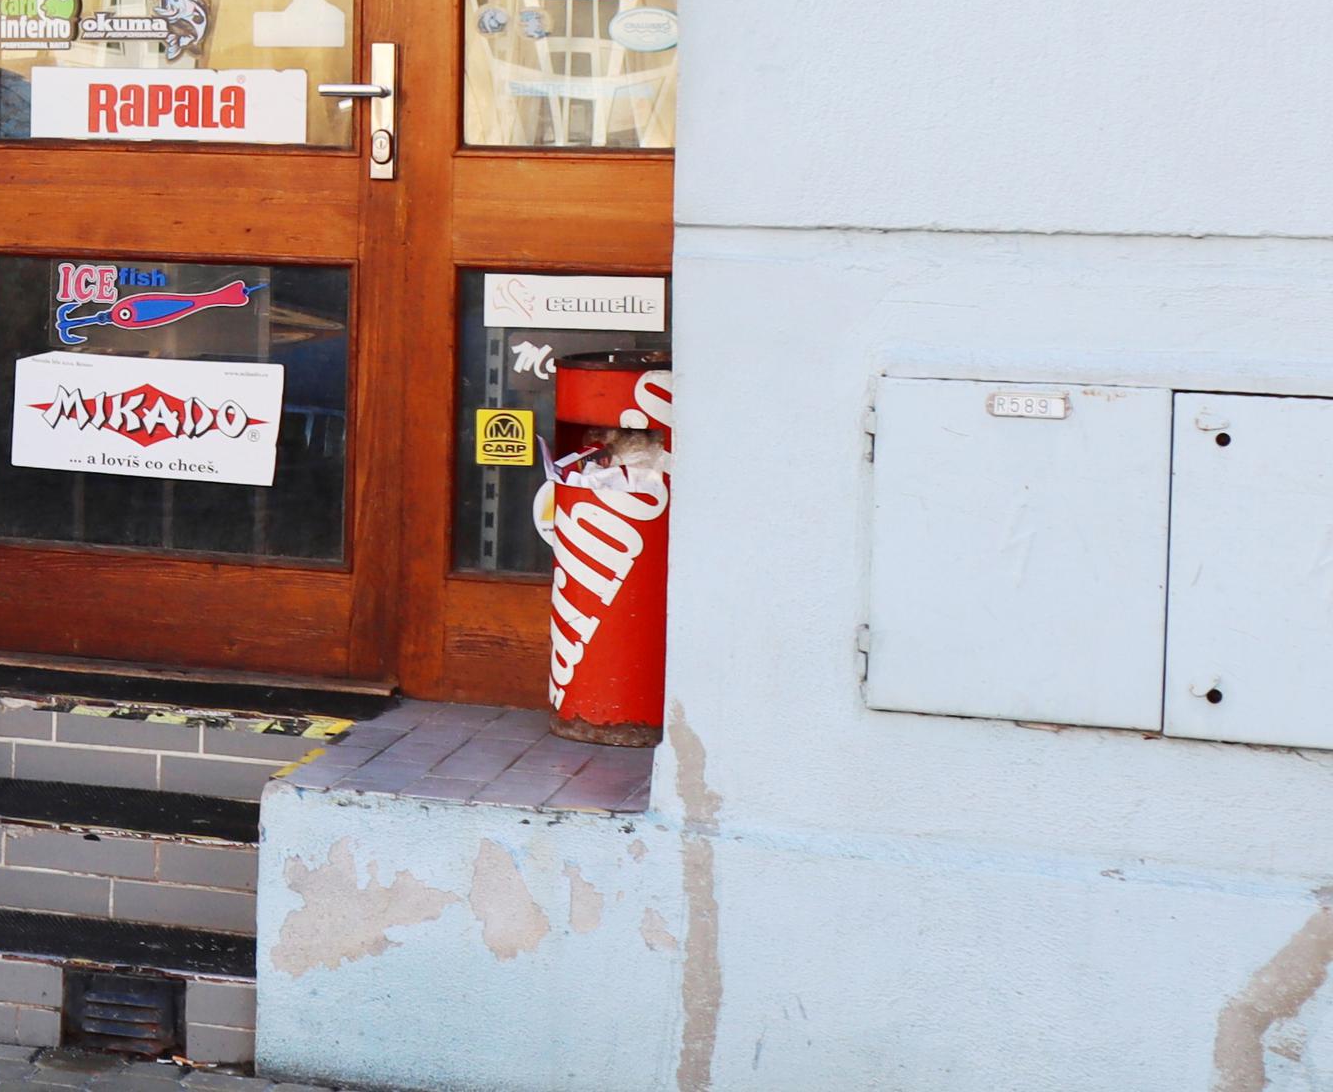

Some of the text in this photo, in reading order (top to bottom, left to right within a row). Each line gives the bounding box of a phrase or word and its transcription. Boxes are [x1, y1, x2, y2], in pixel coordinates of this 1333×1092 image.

[1, 15, 71, 38] inferno
[82, 13, 168, 32] okuma
[546, 296, 657, 315] cannelle
[41, 385, 249, 439] MIKADO
[996, 397, 1049, 414] R589
[483, 443, 527, 453] CARP
[87, 455, 96, 465] a
[101, 453, 140, 468] lovíš
[145, 461, 163, 470] co
[168, 458, 219, 474] chceš.
